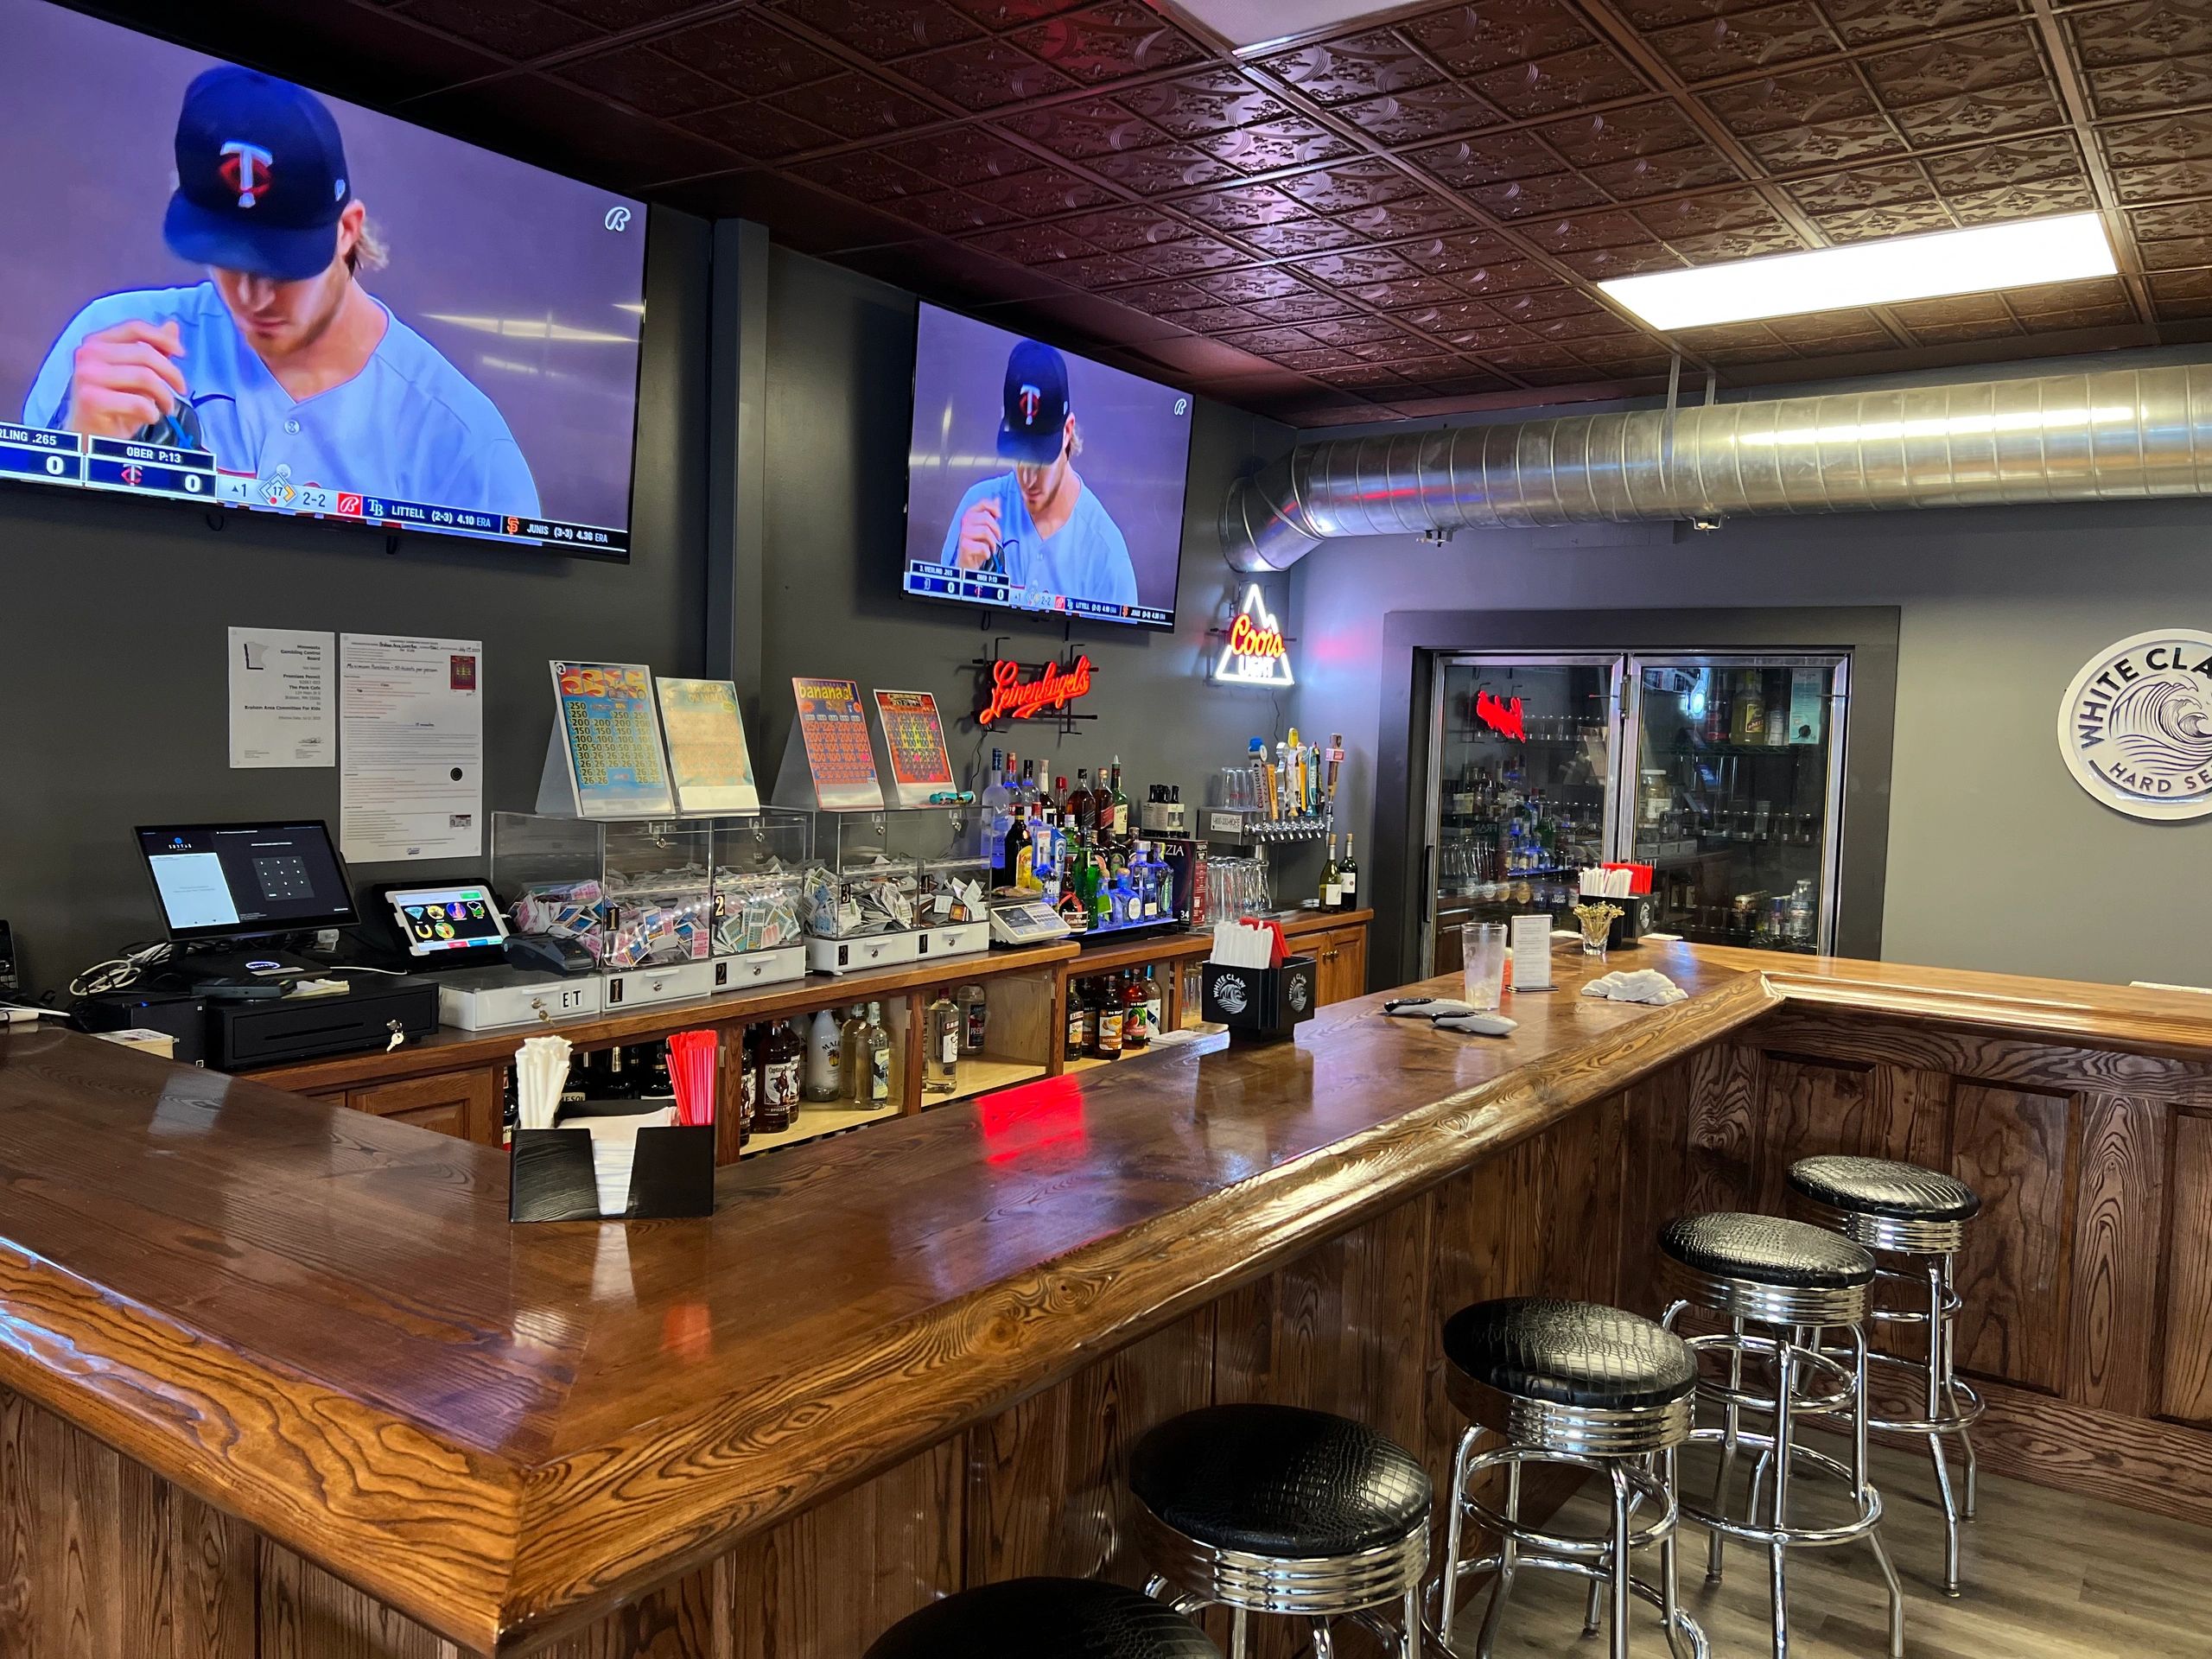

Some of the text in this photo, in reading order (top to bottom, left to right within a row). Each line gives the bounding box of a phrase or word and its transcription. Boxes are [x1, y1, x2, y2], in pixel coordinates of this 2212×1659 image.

[32, 433, 57, 446] .265
[126, 446, 181, 463] OBER P:13
[46, 455, 64, 474] 0
[184, 474, 200, 493] 0
[273, 486, 283, 497] 17
[302, 492, 326, 507] 2-2
[391, 505, 425, 518] LITTELL
[431, 510, 453, 524] (2-3)
[457, 513, 474, 525] 4.10
[477, 516, 491, 528] ERA
[526, 523, 550, 536] JUNIS
[554, 526, 573, 538] (3-3)
[594, 531, 608, 543] ERA
[947, 582, 955, 594] 0
[997, 589, 1005, 601] 0
[1231, 613, 1286, 658] Coors
[2078, 658, 2139, 749] WHITE
[2108, 762, 2171, 792] HARD
[842, 885, 849, 903] 3
[921, 876, 929, 893] 4
[715, 895, 724, 917] 2
[1180, 910, 1189, 918] 34
[609, 908, 616, 930] 1
[919, 935, 927, 953] 4
[840, 946, 848, 964] 3
[717, 964, 725, 984] 2
[613, 980, 620, 1001] 1
[1213, 973, 1246, 998] WHITE CLAW
